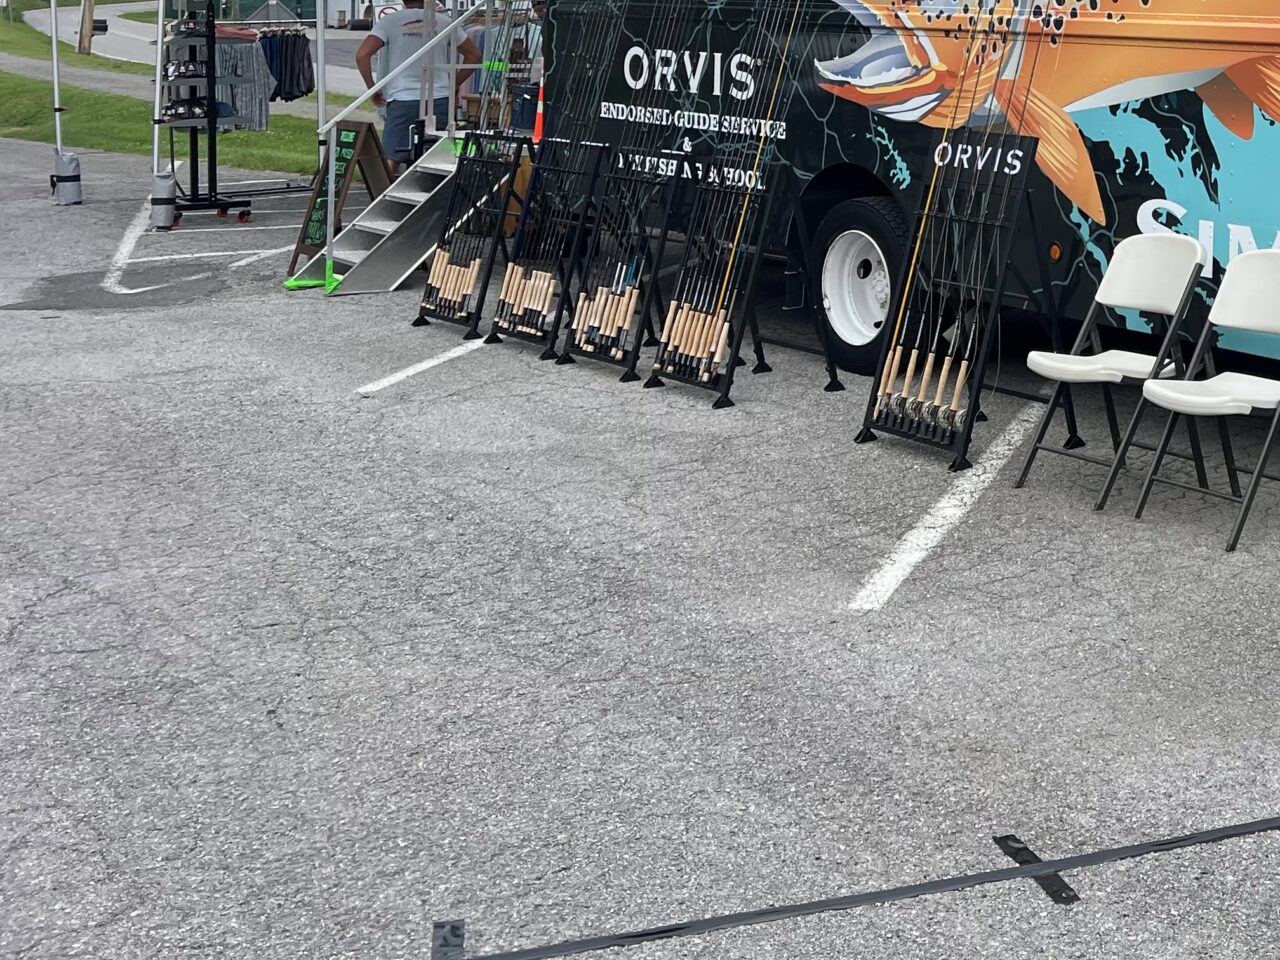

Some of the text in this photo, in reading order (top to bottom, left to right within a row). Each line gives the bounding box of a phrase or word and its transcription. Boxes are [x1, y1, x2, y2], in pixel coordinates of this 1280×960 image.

[623, 46, 755, 101] ORVIS
[600, 101, 787, 140] ENDORSED GUIDE SERVICE
[682, 136, 693, 152] &
[934, 141, 1024, 176] ORVIS
[644, 156, 703, 180] FISHNG
